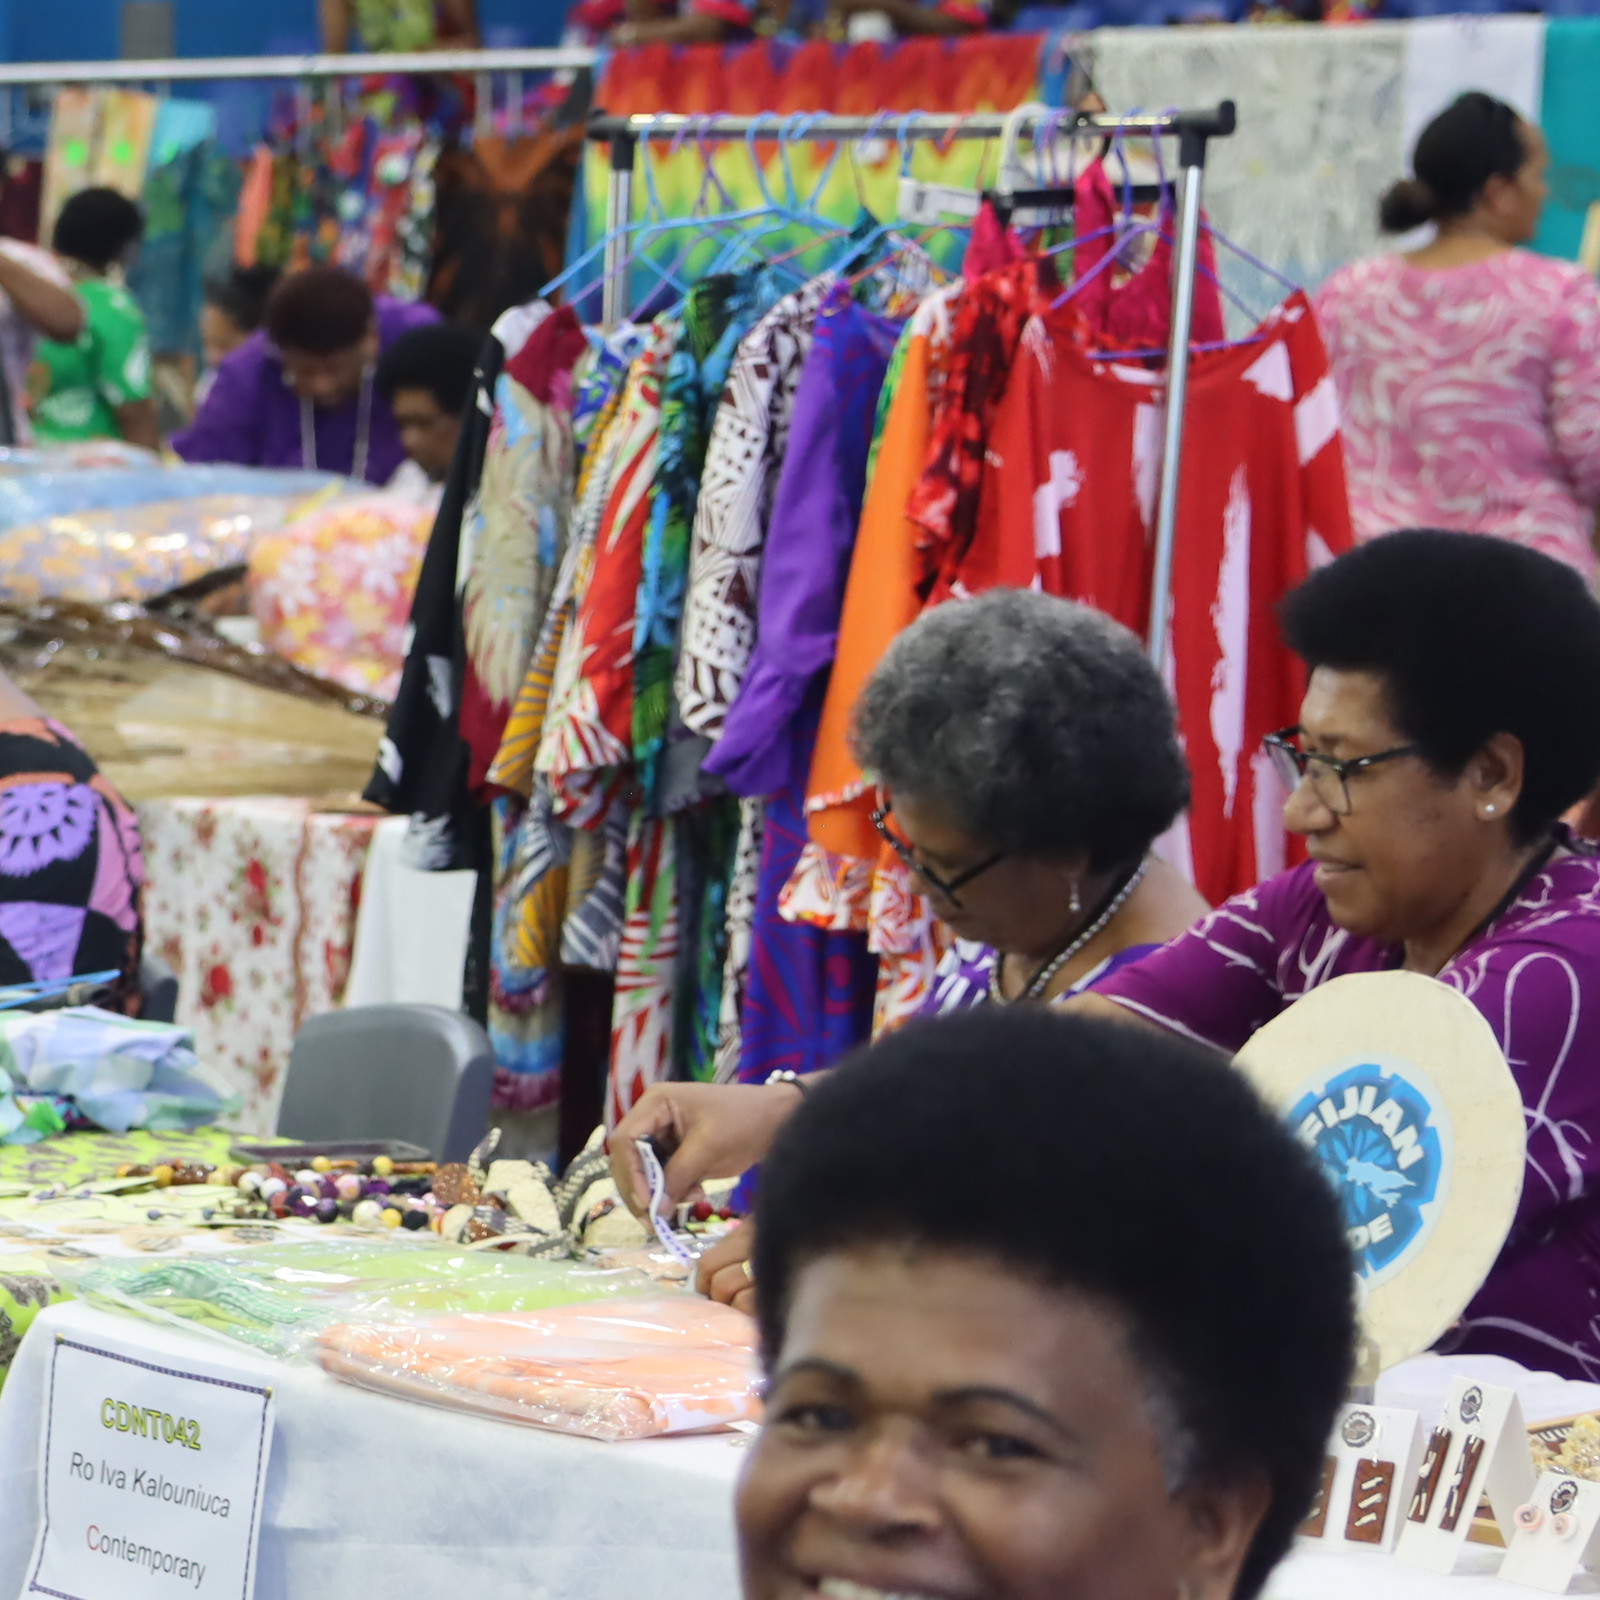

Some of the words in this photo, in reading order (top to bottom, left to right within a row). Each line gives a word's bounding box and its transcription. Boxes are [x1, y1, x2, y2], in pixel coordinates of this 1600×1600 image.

[1346, 1212, 1395, 1250] DE
[100, 1397, 202, 1451] CDNT042
[69, 1451, 95, 1482] Ro
[100, 1459, 126, 1491] Iva
[131, 1467, 231, 1518] Kalouniuca
[86, 1524, 207, 1589] Contemporary
